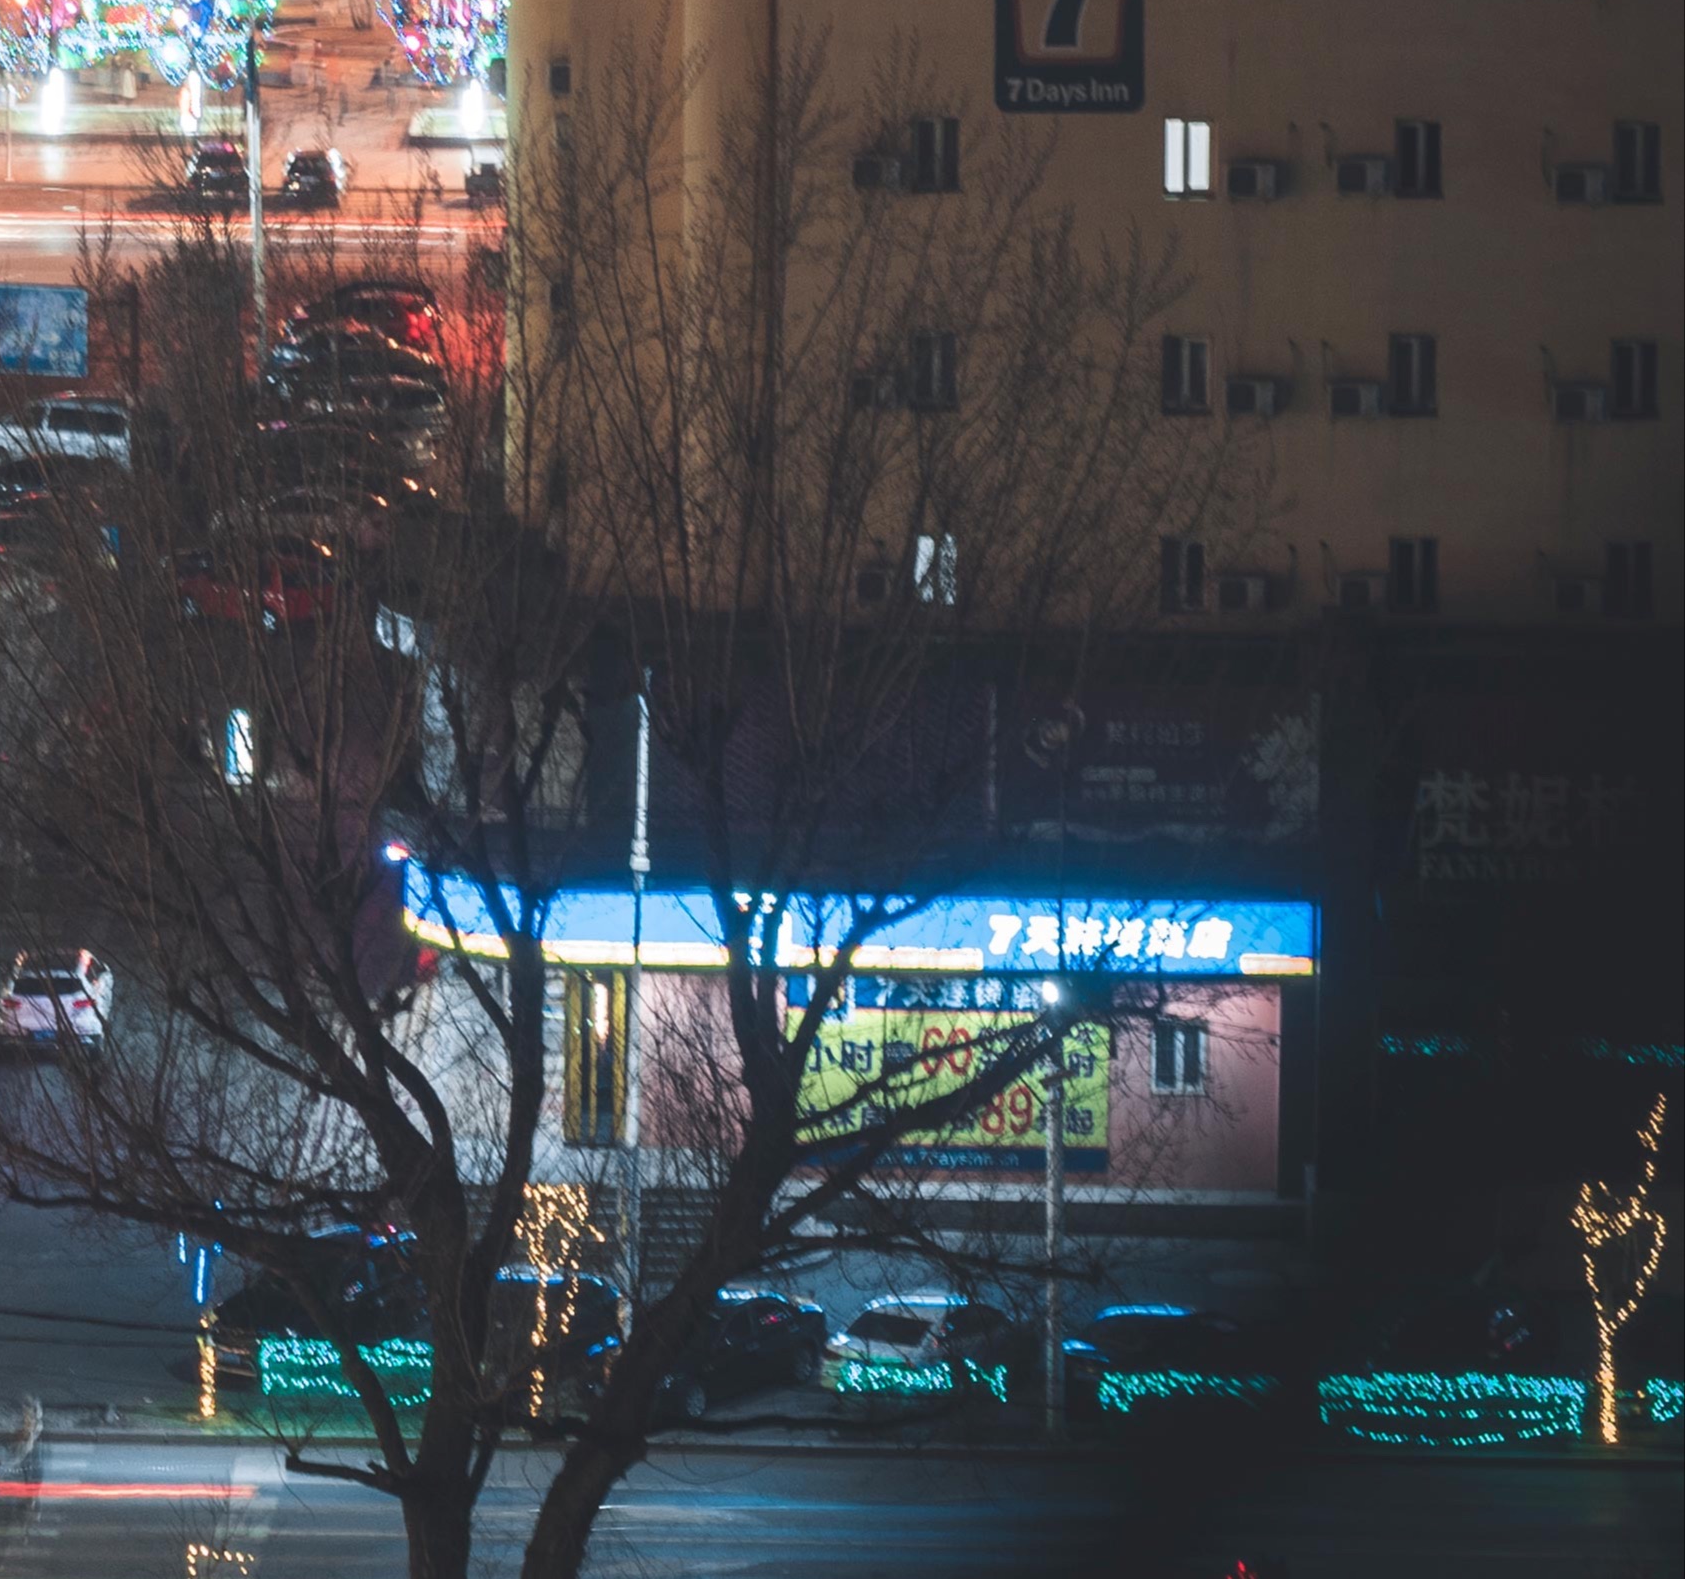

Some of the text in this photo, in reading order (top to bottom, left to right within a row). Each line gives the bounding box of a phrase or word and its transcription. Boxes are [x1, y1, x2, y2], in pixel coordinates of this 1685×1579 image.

[1006, 77, 1129, 106] 7 Days Inn
